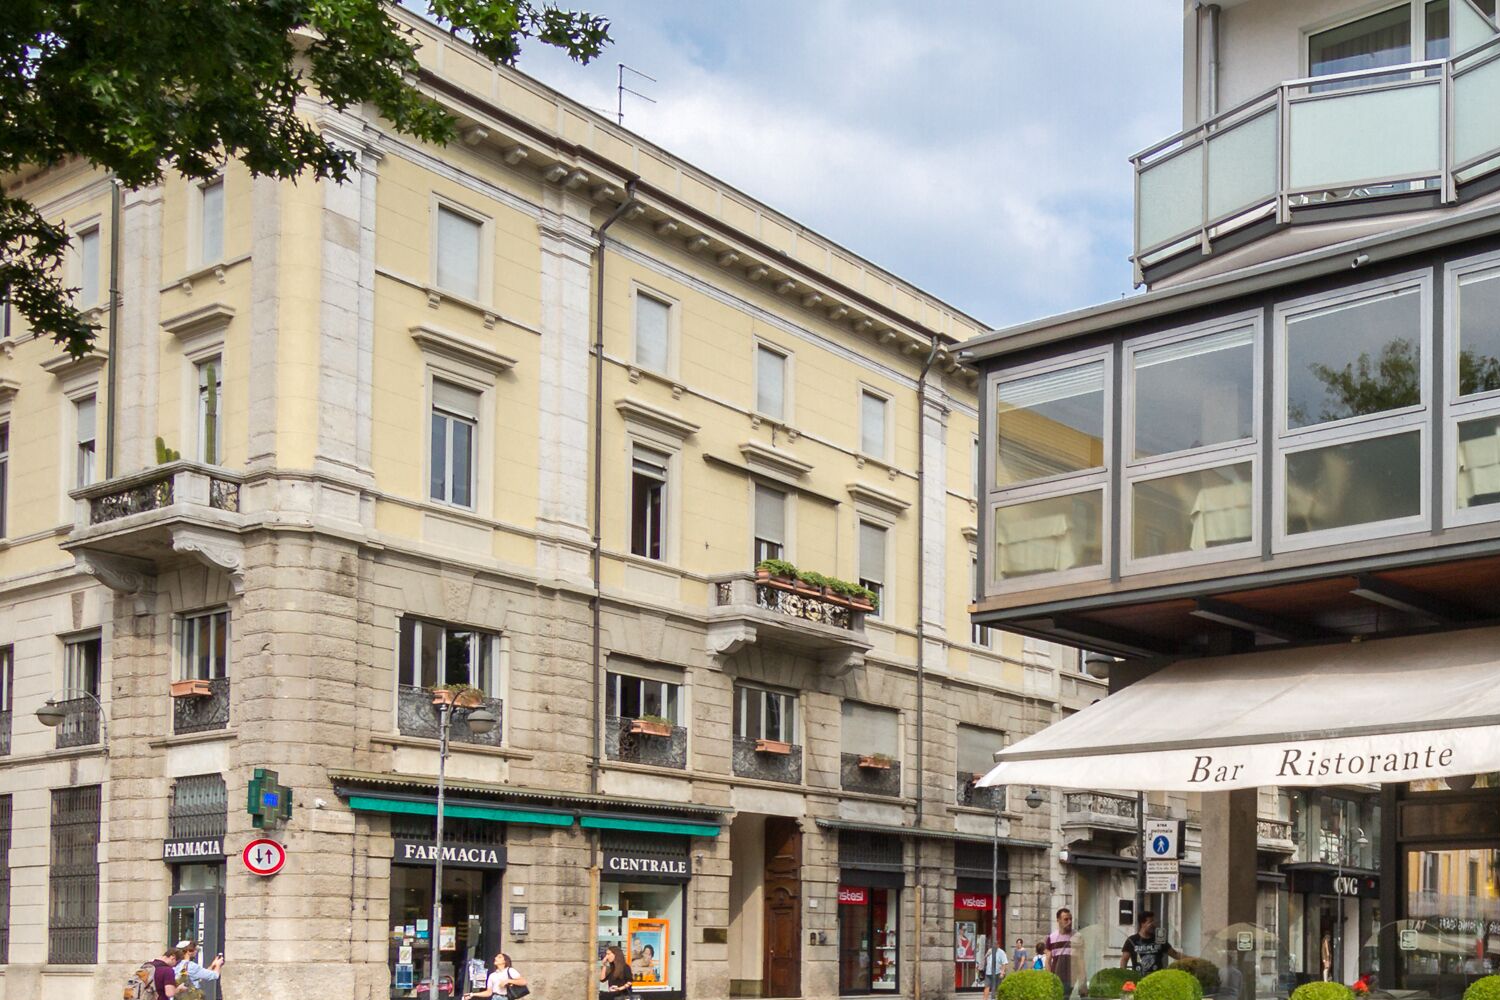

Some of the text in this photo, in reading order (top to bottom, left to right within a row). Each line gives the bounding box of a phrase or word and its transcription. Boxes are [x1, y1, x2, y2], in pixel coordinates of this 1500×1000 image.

[1187, 745, 1454, 783] Bar Ristorante
[164, 840, 221, 858] FARMACIA
[404, 844, 499, 864] FARMACIA
[609, 856, 687, 874] CENTRALE
